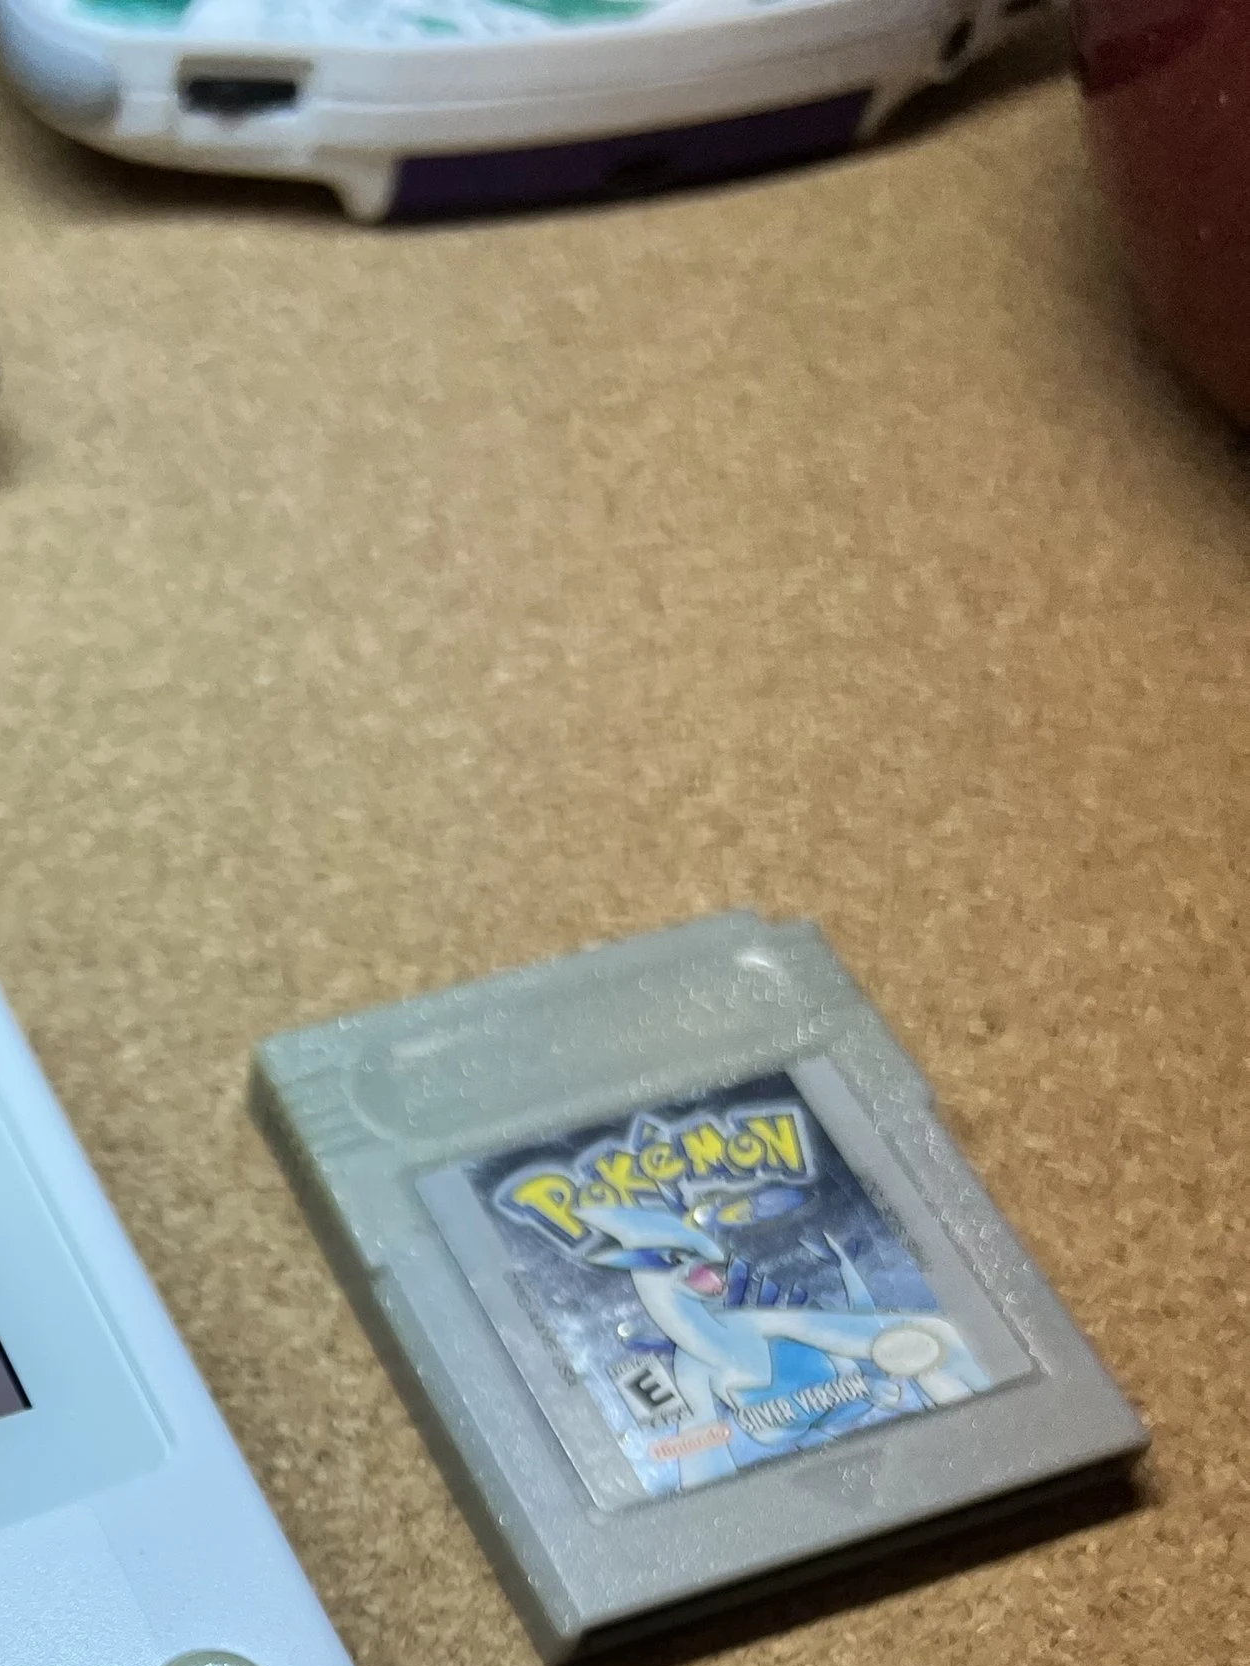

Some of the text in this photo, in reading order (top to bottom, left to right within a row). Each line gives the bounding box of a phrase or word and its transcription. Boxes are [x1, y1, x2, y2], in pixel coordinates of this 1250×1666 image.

[624, 1368, 676, 1407] E
[736, 1373, 871, 1433] SILVER VERSION
